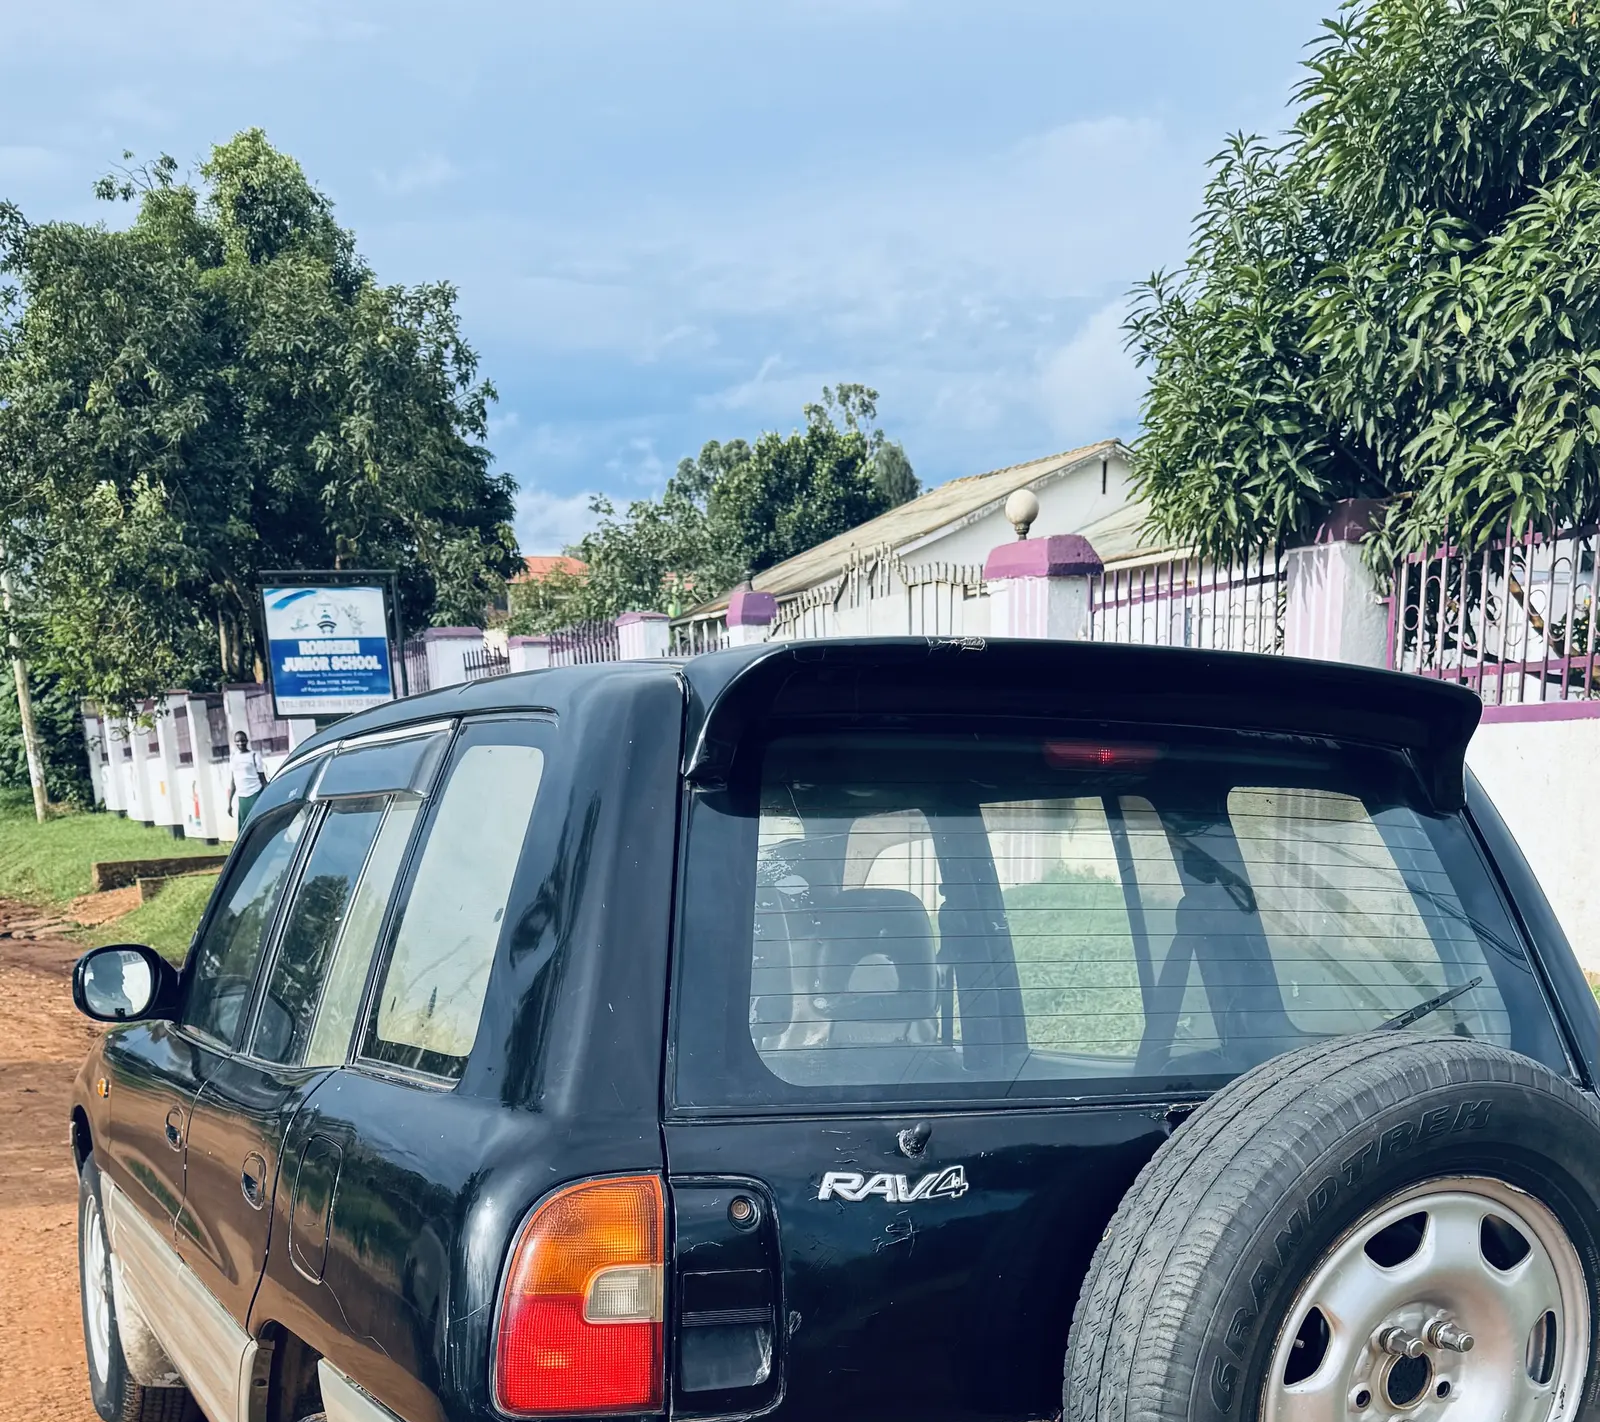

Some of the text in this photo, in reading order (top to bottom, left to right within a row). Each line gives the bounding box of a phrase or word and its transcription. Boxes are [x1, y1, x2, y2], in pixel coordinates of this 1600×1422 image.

[282, 655, 383, 672] JUNIOR SCHOOL
[817, 1164, 969, 1203] RAV4
[1209, 1099, 1493, 1415] GRANDTREK
